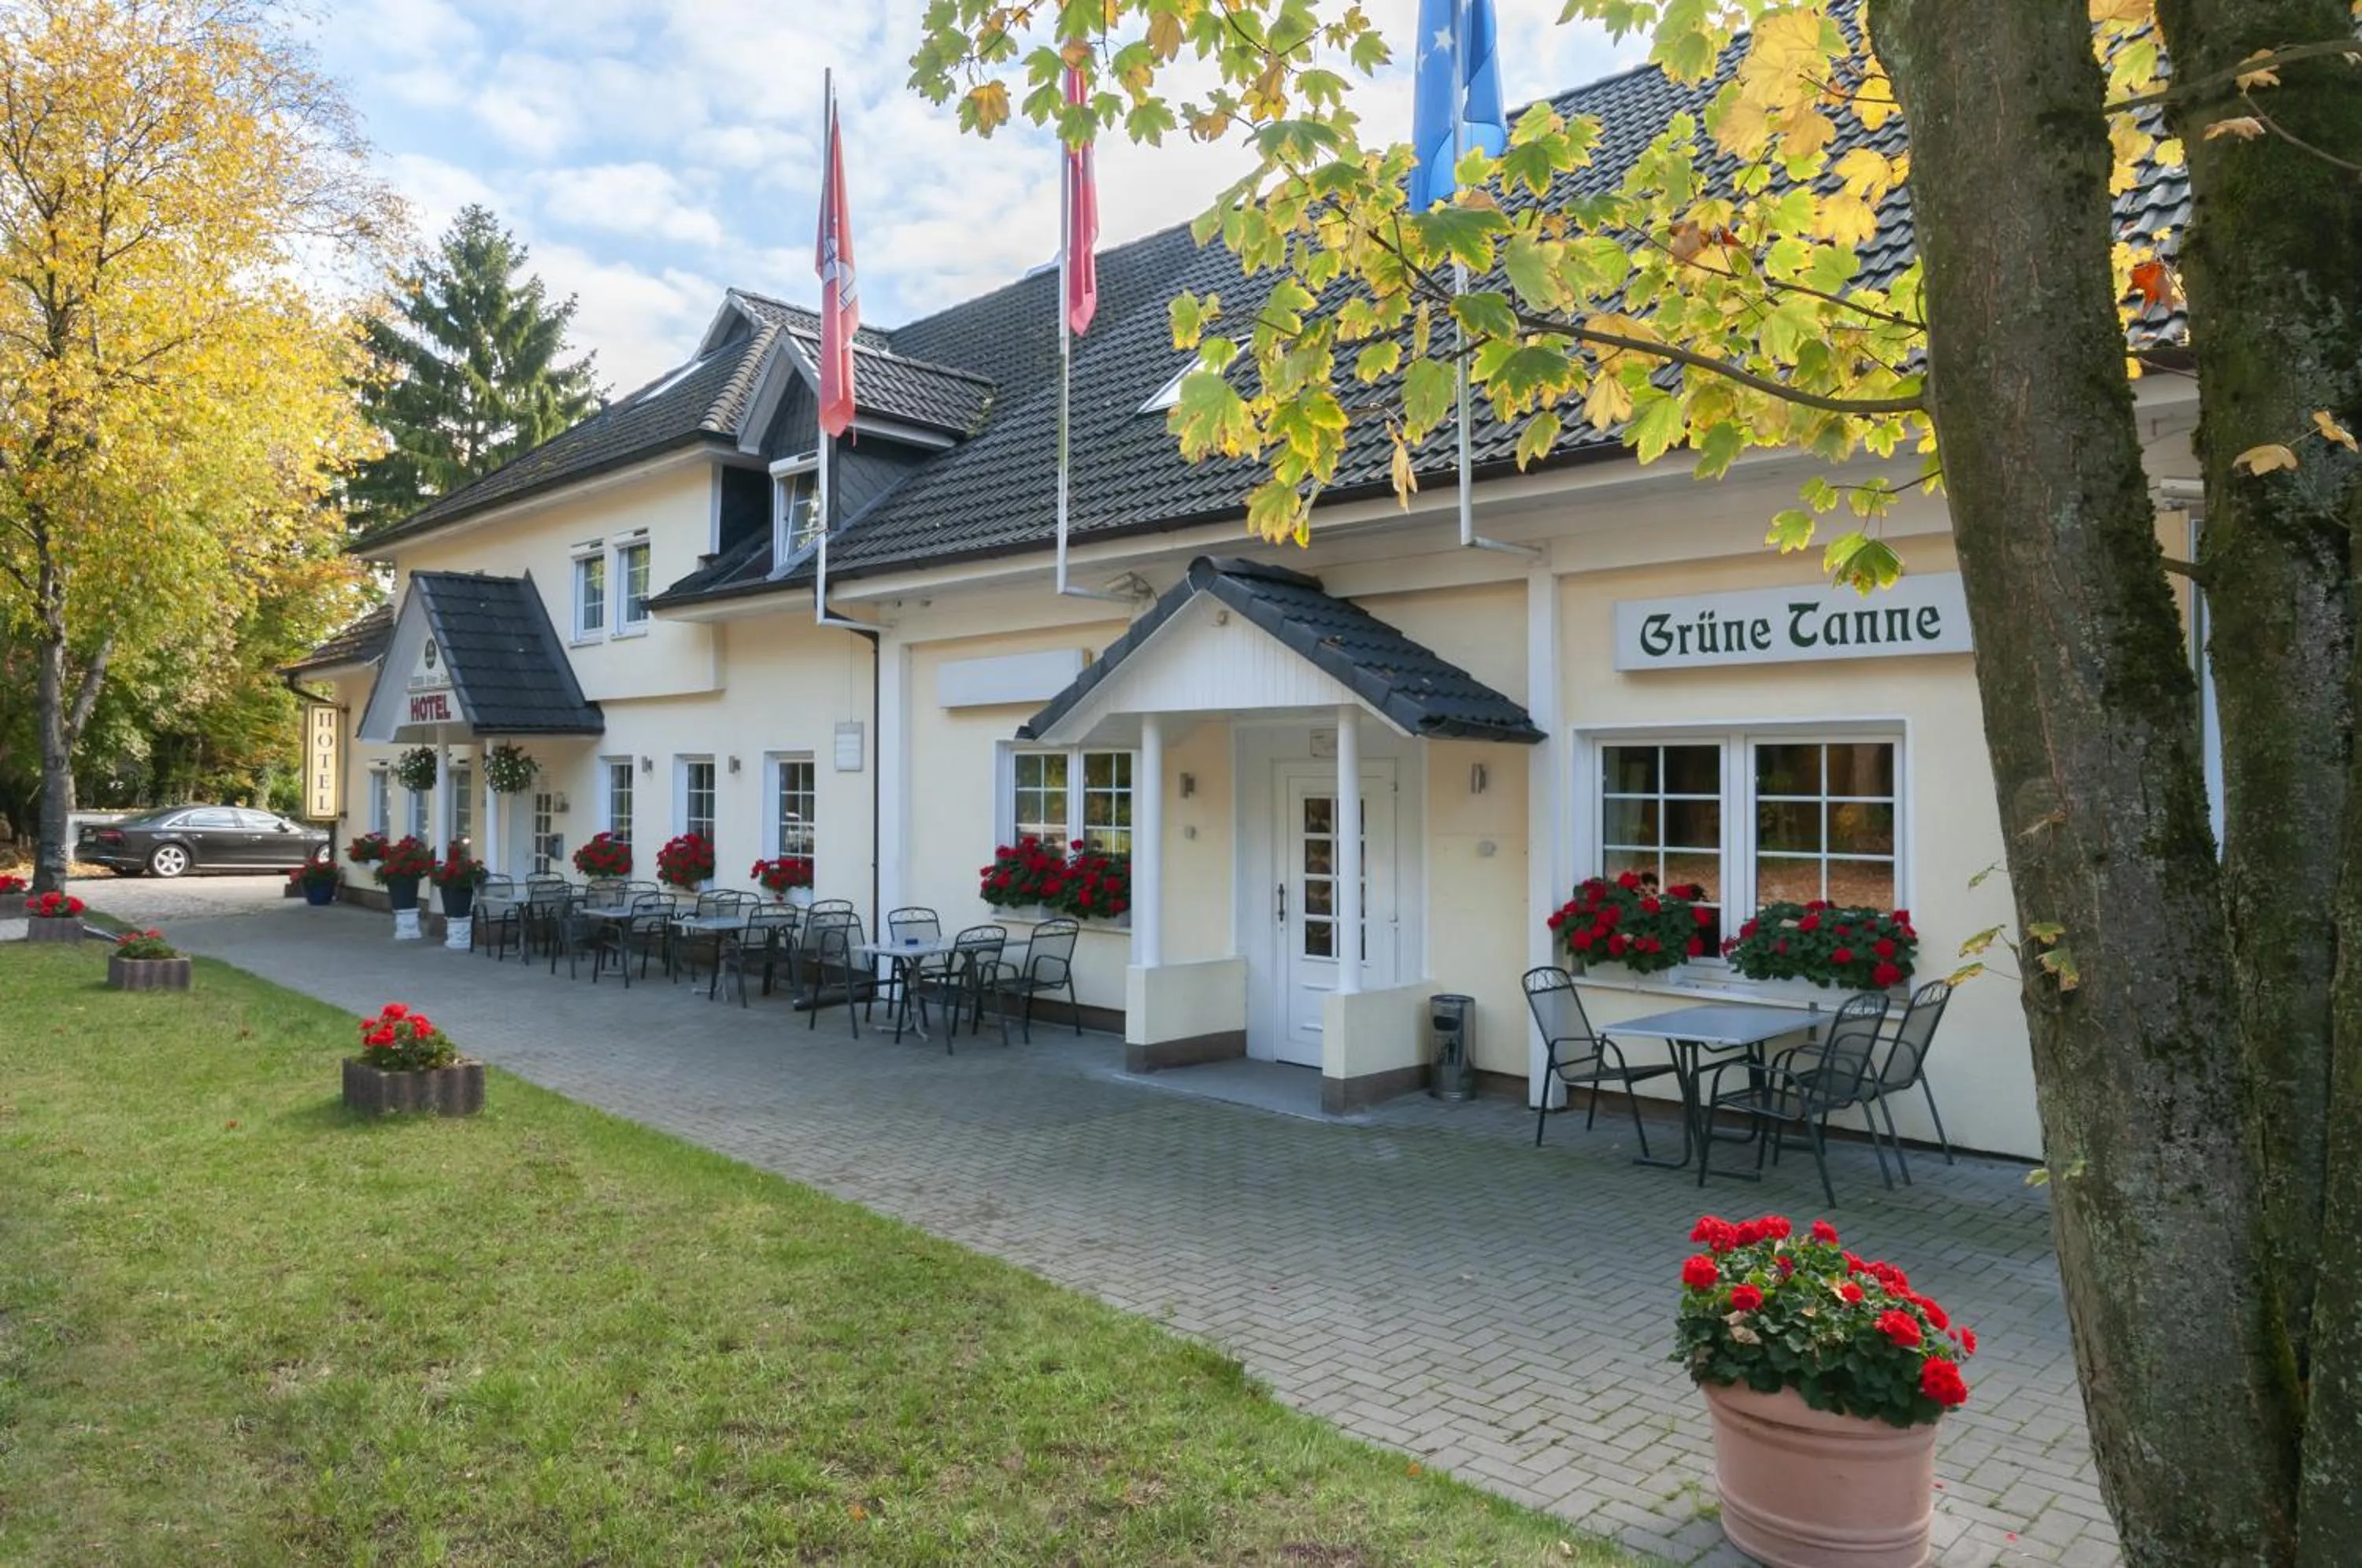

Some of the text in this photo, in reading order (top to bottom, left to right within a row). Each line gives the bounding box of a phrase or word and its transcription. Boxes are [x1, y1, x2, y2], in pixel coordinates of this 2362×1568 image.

[1640, 601, 1941, 656] Grüne Tanne
[410, 693, 451, 722] HOTEL
[317, 712, 333, 811] HOTEL
